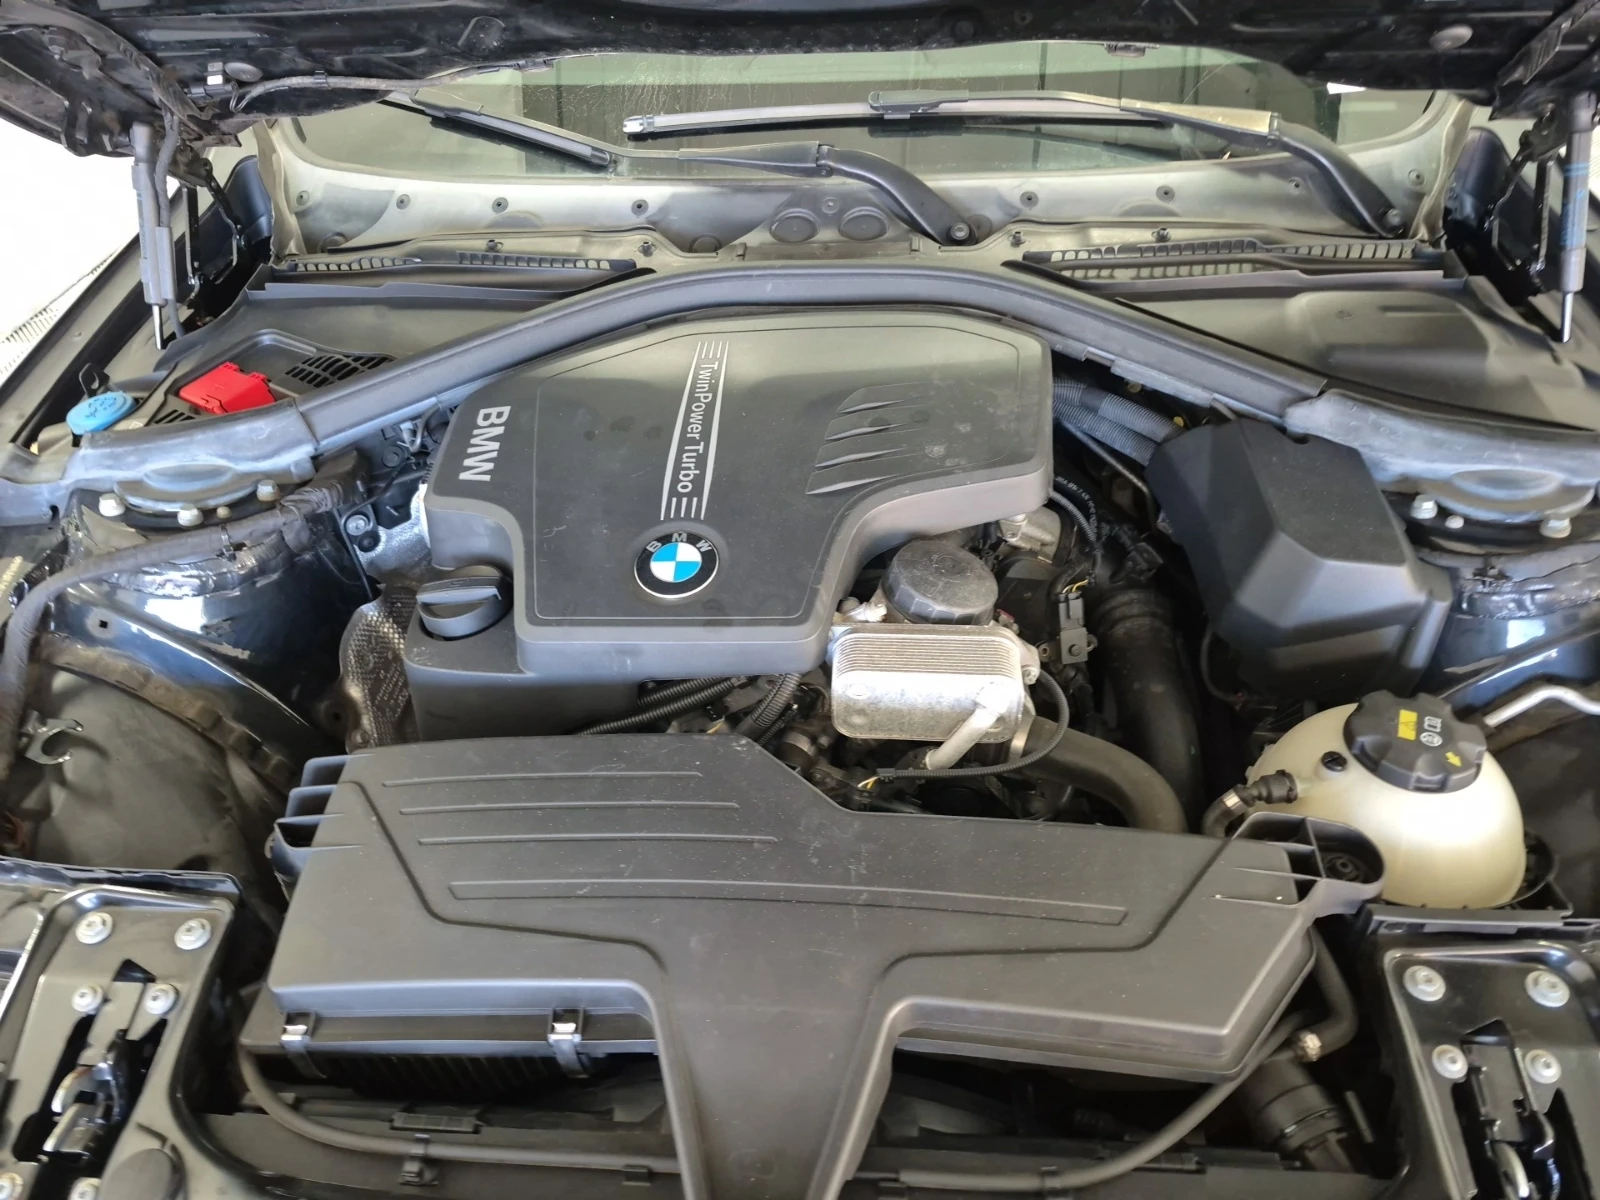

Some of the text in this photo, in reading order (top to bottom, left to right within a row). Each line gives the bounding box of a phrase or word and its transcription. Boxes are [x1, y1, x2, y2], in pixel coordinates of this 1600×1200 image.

[458, 405, 511, 482] BMW
[677, 361, 718, 493] TwinPower Turbo
[645, 531, 712, 553] BMW
